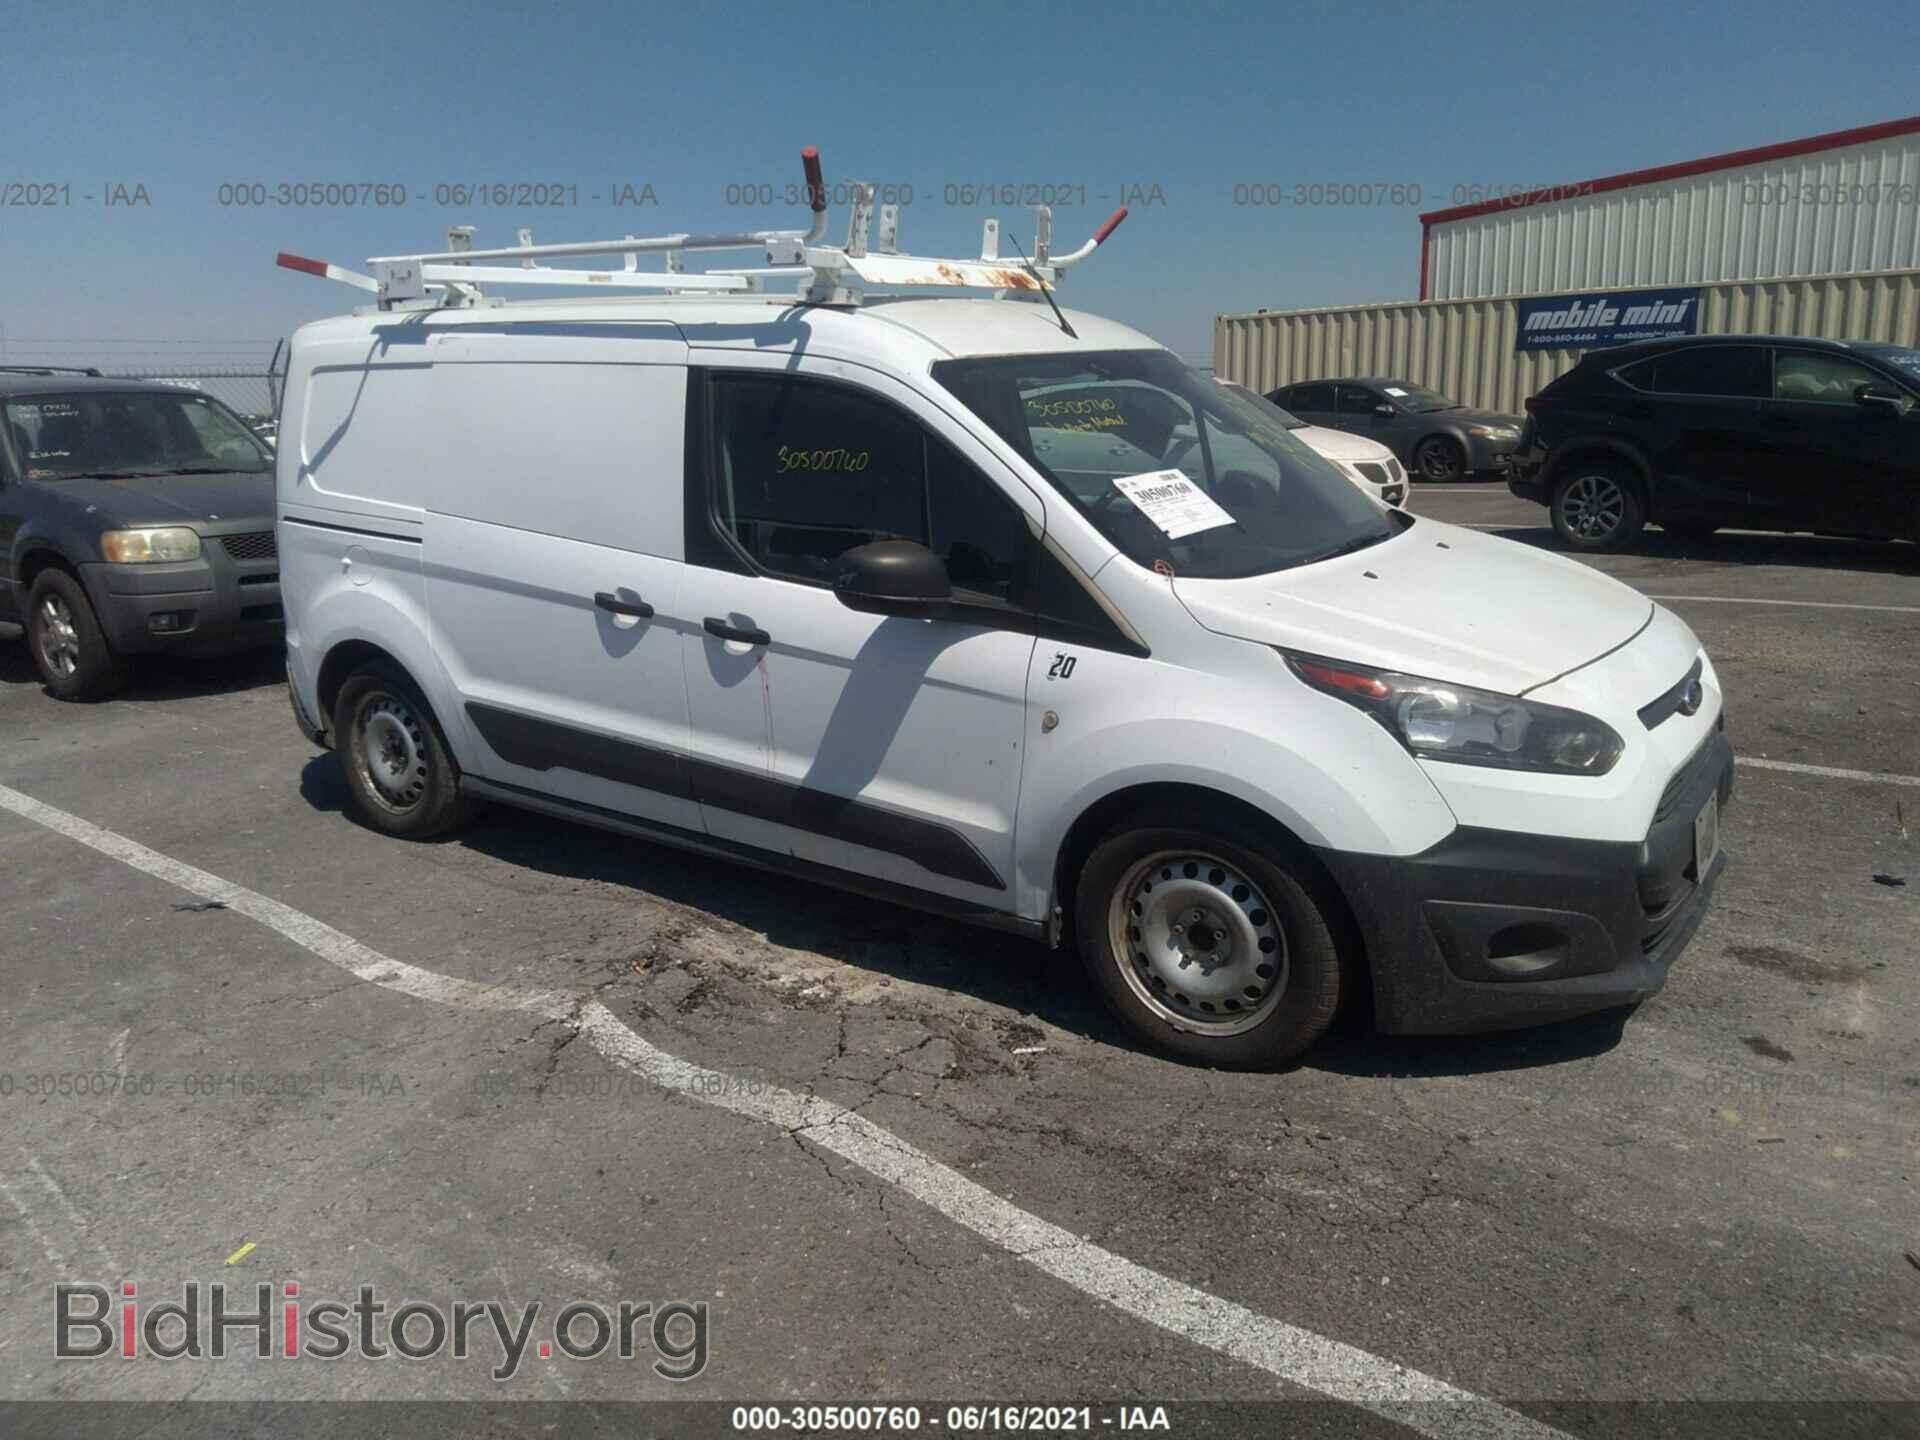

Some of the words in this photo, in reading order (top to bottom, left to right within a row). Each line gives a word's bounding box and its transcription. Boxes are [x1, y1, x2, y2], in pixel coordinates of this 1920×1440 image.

[1524, 300, 1619, 331] mobile
[1620, 300, 1690, 326] mini
[1048, 654, 1078, 679] 20
